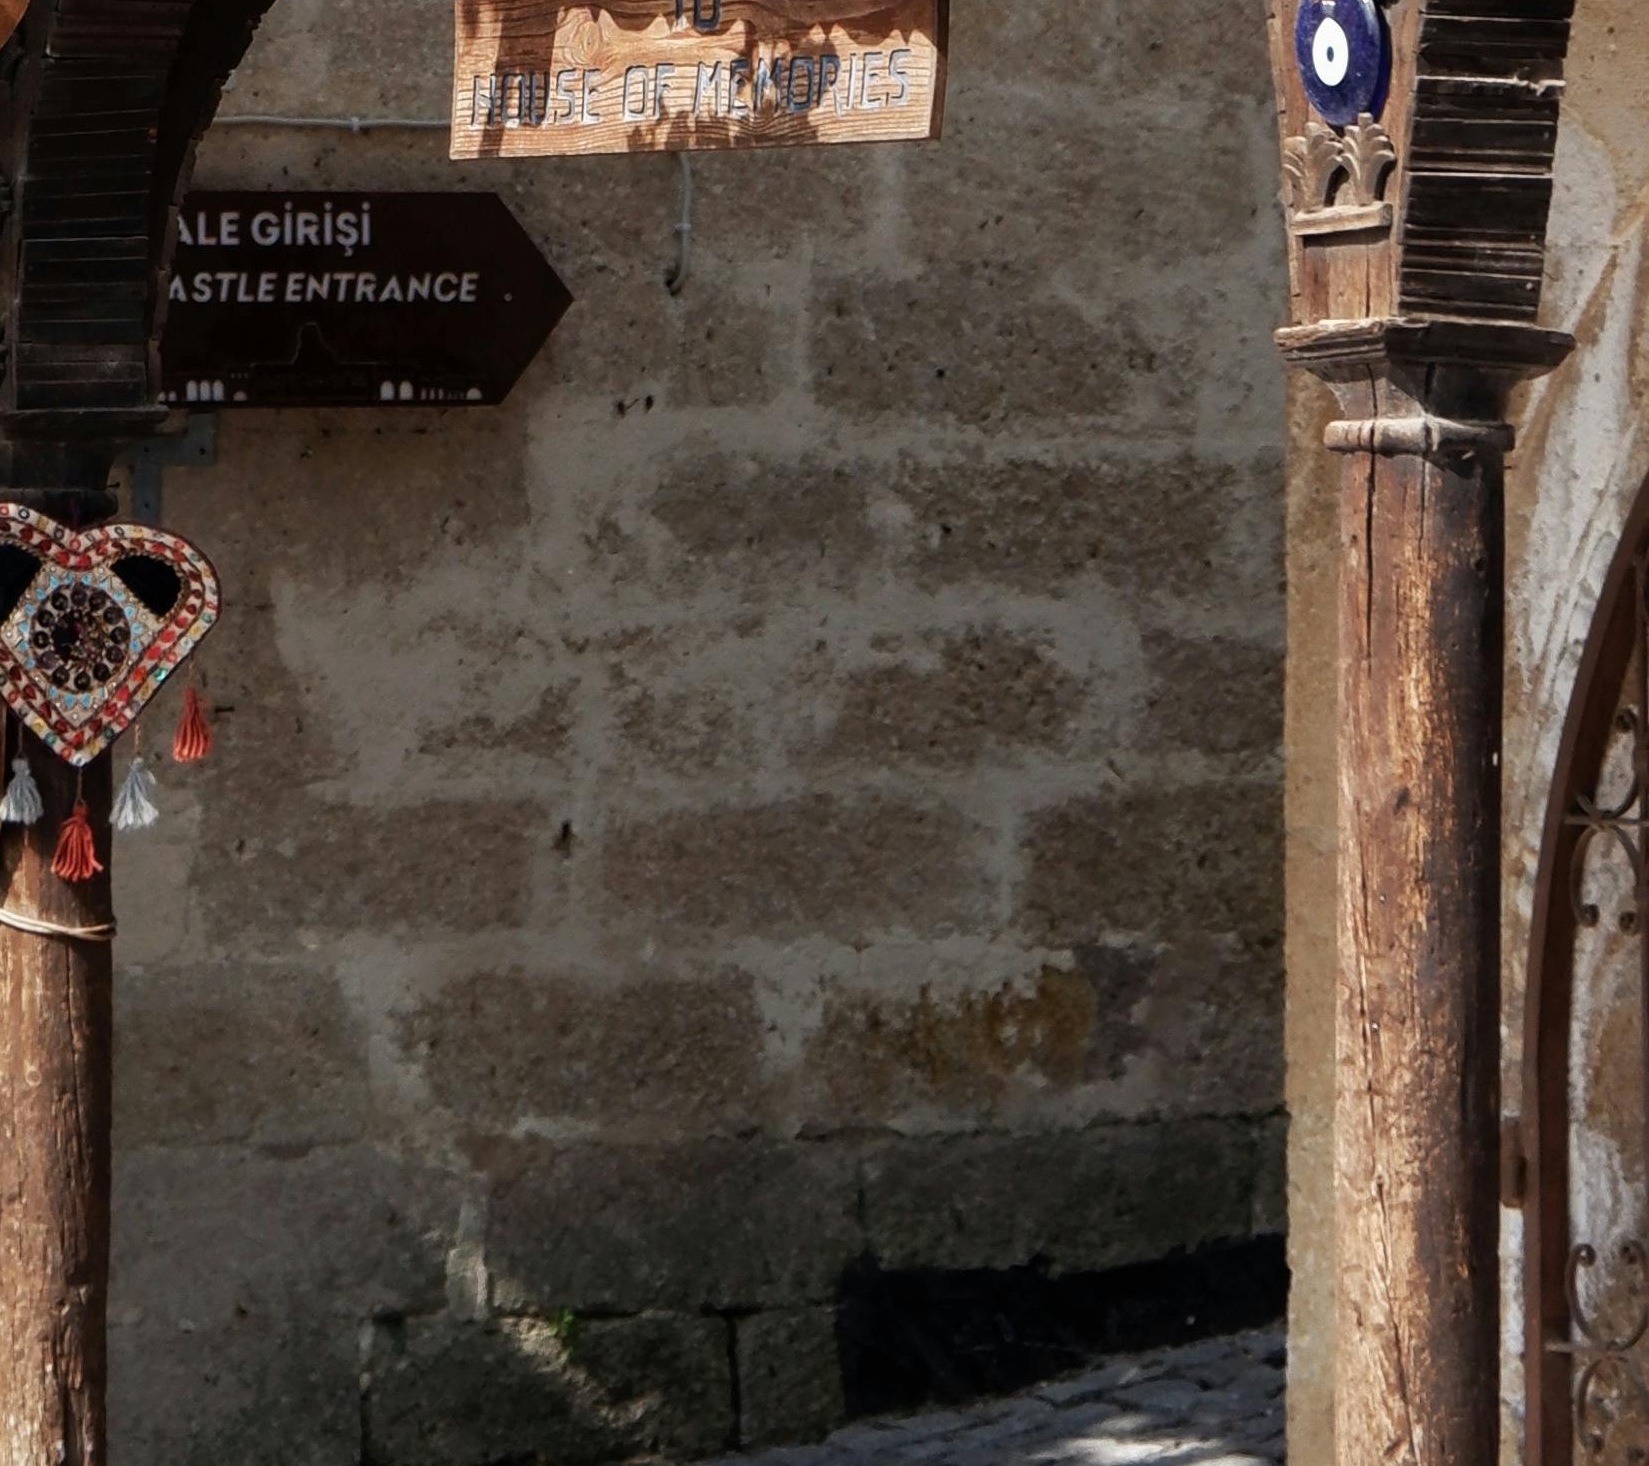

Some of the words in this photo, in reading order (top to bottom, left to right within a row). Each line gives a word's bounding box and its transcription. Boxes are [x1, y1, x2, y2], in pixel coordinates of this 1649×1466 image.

[470, 66, 602, 130] HOUSE
[622, 61, 676, 123] OF
[693, 48, 912, 120] MEMORIES
[250, 201, 372, 257] GİRİŞİ
[284, 272, 481, 303] ENTRANCE
